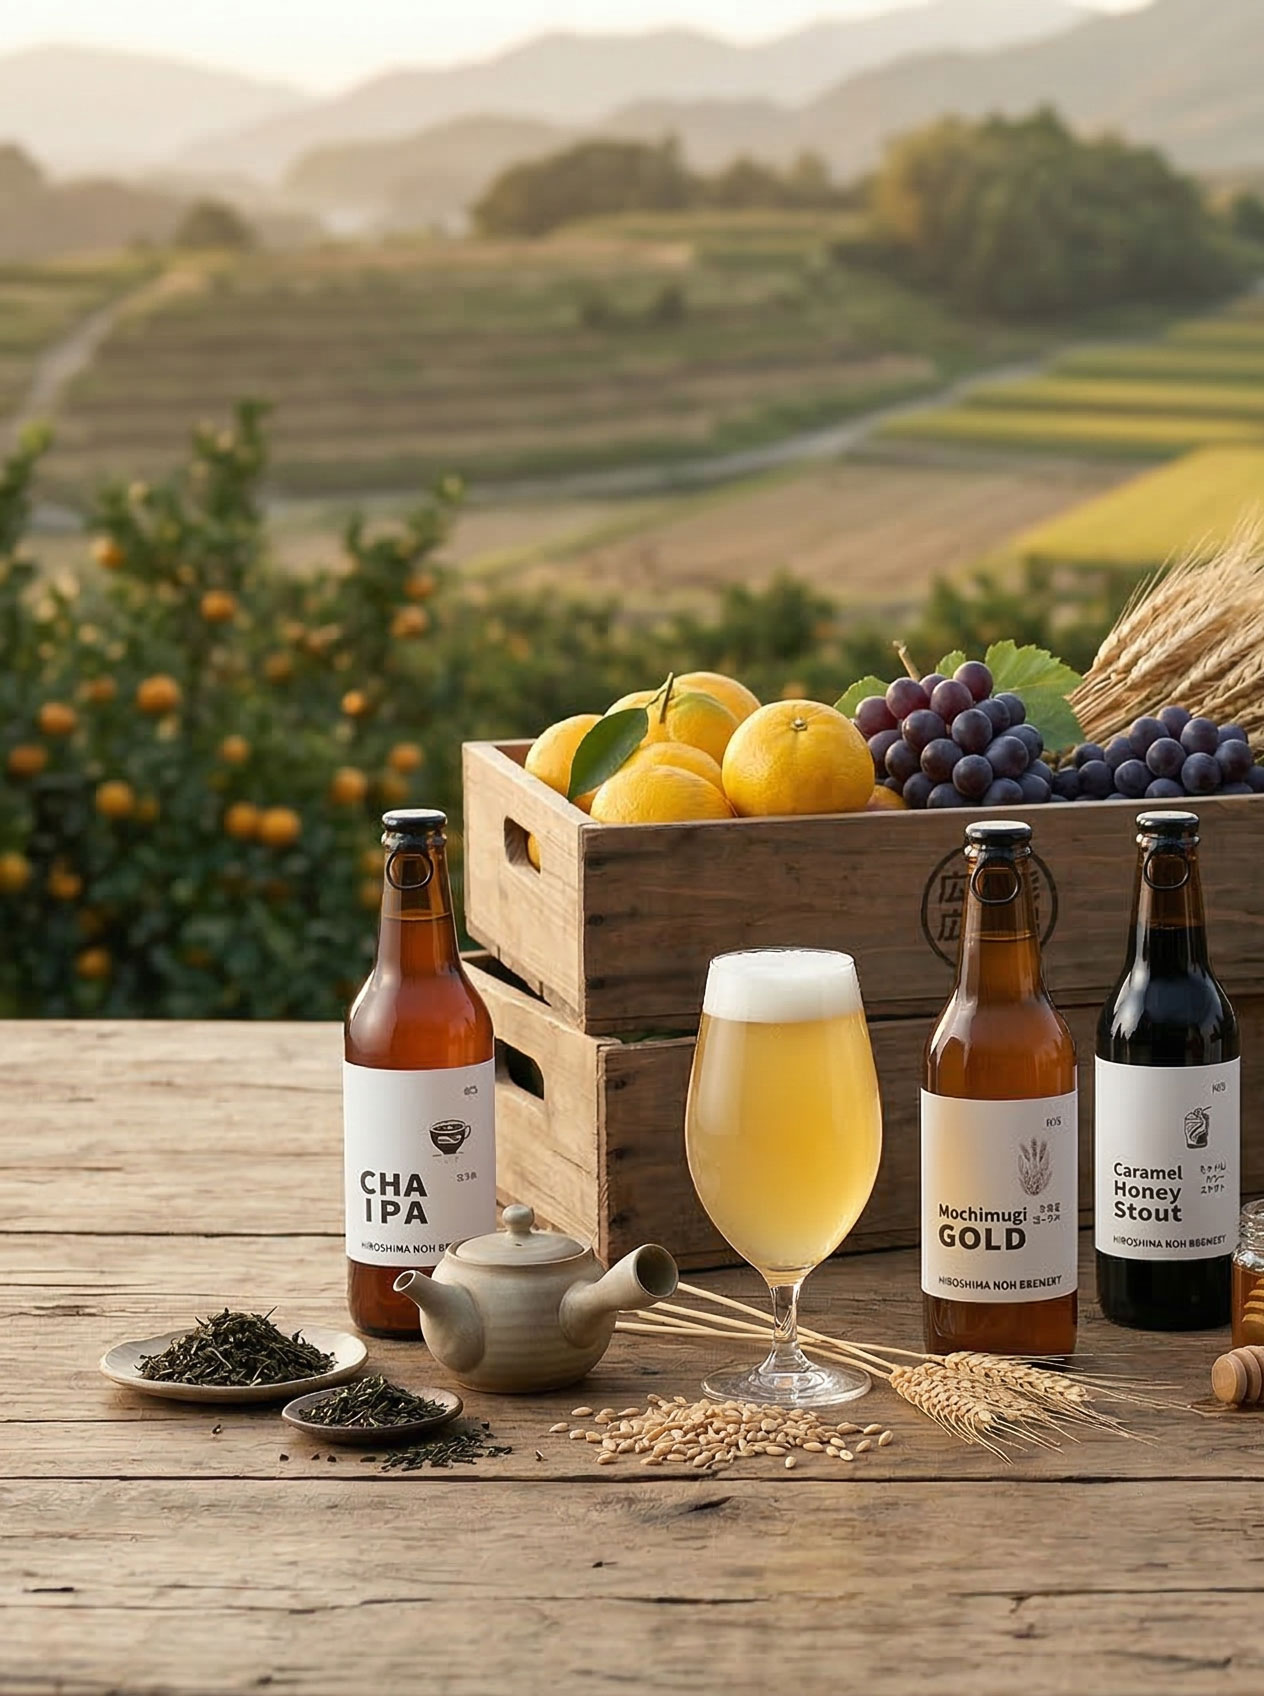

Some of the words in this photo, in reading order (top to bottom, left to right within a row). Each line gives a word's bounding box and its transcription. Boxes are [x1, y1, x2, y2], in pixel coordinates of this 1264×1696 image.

[1113, 1162, 1183, 1181] Caramel
[360, 1170, 428, 1198] CHA
[1113, 1180, 1182, 1205] Honey
[365, 1198, 429, 1225] IPA
[938, 1203, 1028, 1226] Mochimugi
[1113, 1200, 1183, 1222] Stout
[413, 1243, 436, 1254] NOH
[938, 1224, 1026, 1251] GOLD
[993, 1280, 1018, 1291] NOH
